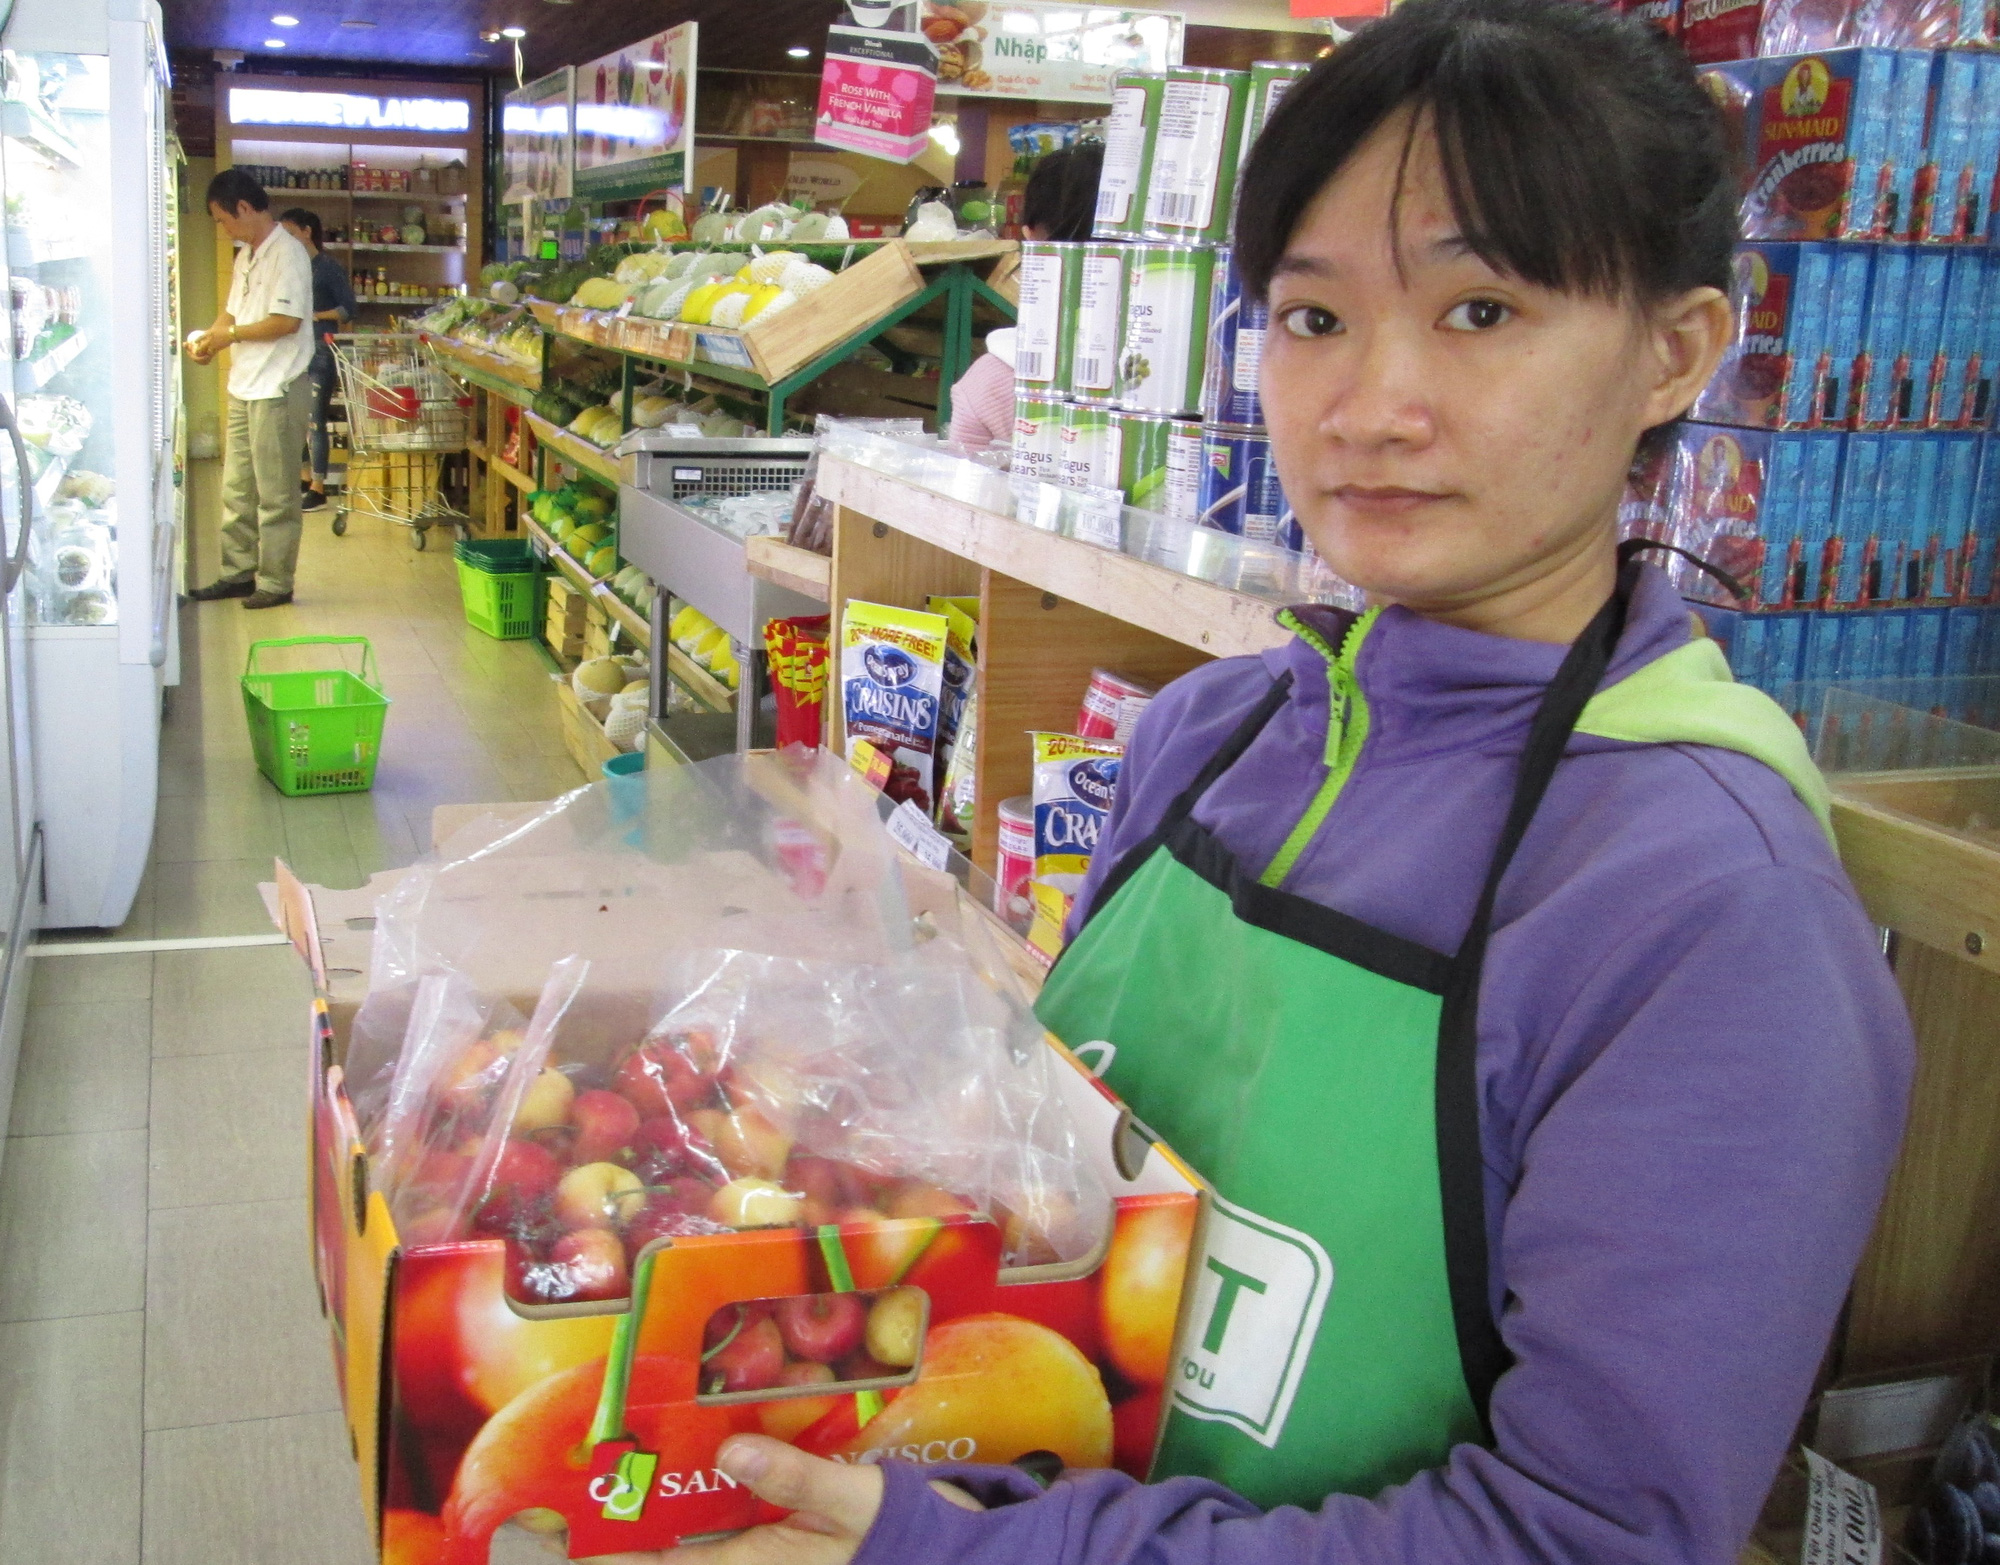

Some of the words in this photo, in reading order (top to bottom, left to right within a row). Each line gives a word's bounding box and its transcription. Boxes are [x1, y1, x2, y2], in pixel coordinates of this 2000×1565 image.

[850, 47, 894, 59] EXCEPTIONAL
[995, 36, 1048, 64] Nhập
[841, 83, 864, 96] ROSE
[865, 86, 891, 101] WITH
[829, 96, 862, 111] FRENCH
[864, 102, 903, 120] VANILLA
[1014, 450, 1053, 464] aragus
[870, 627, 903, 643] MORE
[852, 682, 932, 730] CRAISINS
[859, 721, 912, 745] Pomegranate
[1048, 737, 1081, 756] 20%
[1074, 771, 1108, 799] Ocean
[1182, 1356, 1217, 1391] ou
[659, 1467, 738, 1498] SAN
[830, 1436, 977, 1465] NCISCO
